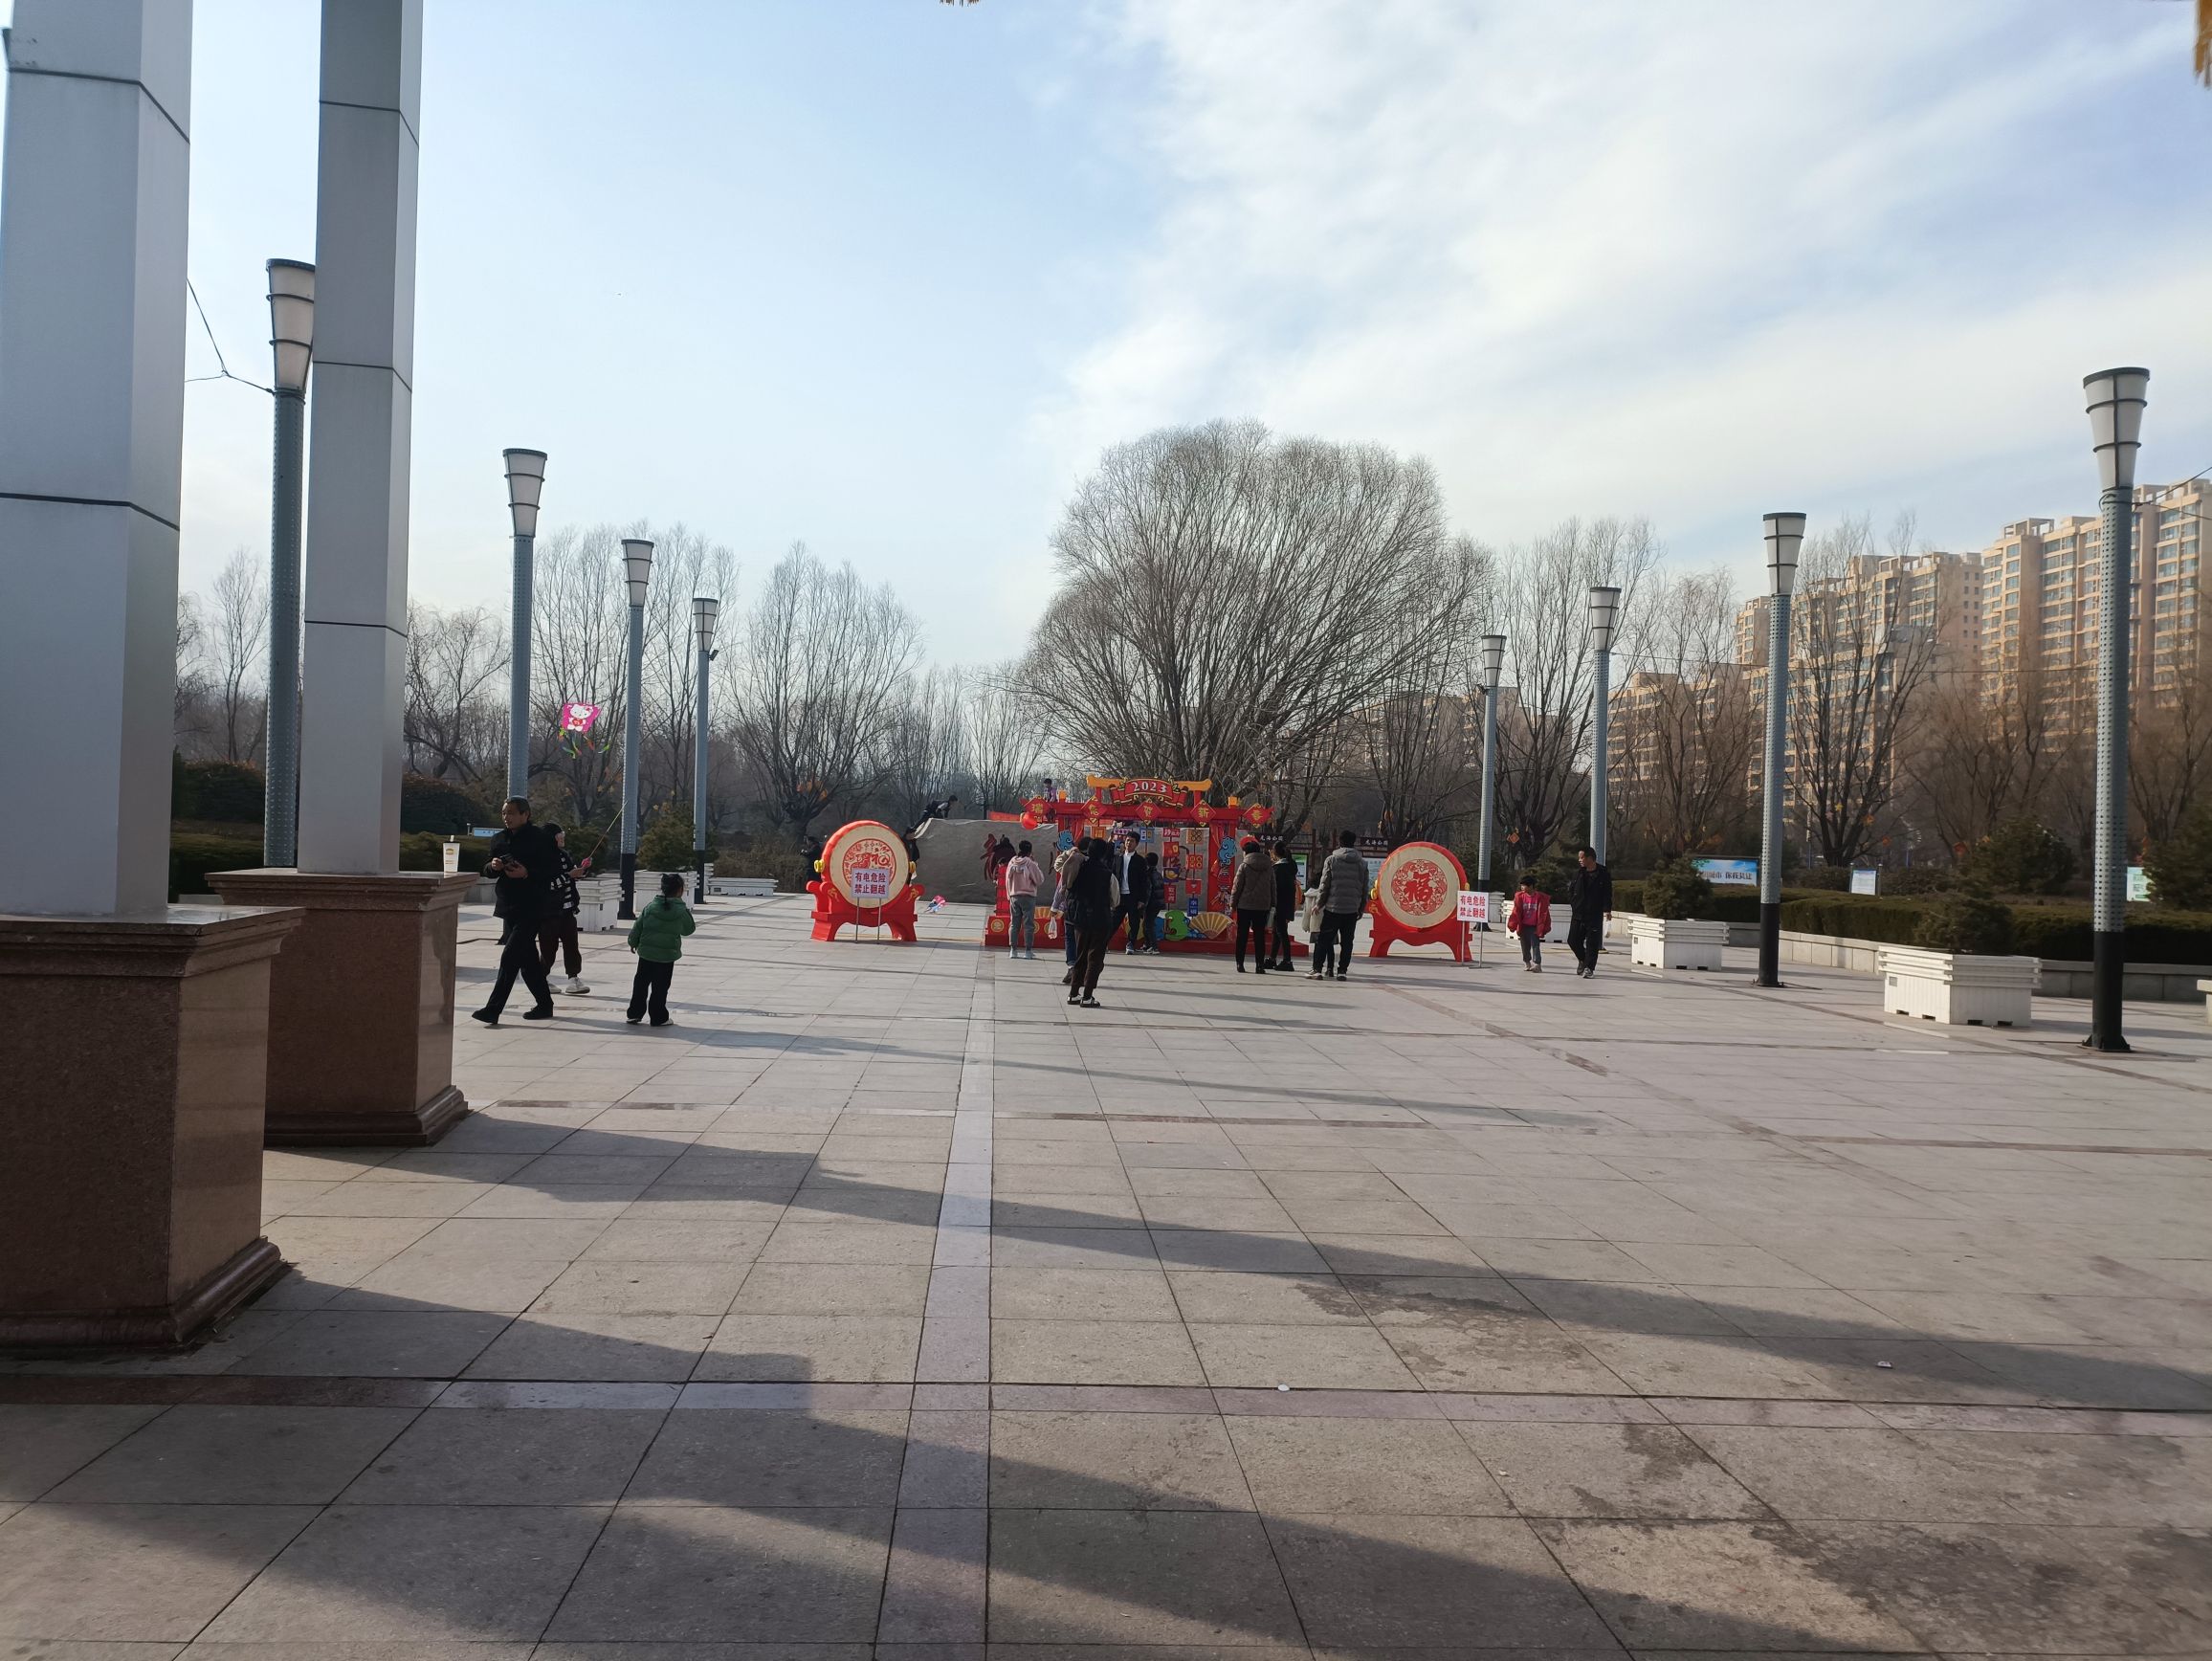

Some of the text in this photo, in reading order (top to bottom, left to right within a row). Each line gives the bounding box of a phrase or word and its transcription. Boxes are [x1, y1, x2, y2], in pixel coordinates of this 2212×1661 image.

[1133, 781, 1167, 793] 2023
[854, 873, 886, 883] 有电危险
[854, 884, 886, 895] 禁止翻越
[1460, 896, 1486, 906] 有电危险
[1460, 908, 1486, 919] 禁止翻越
